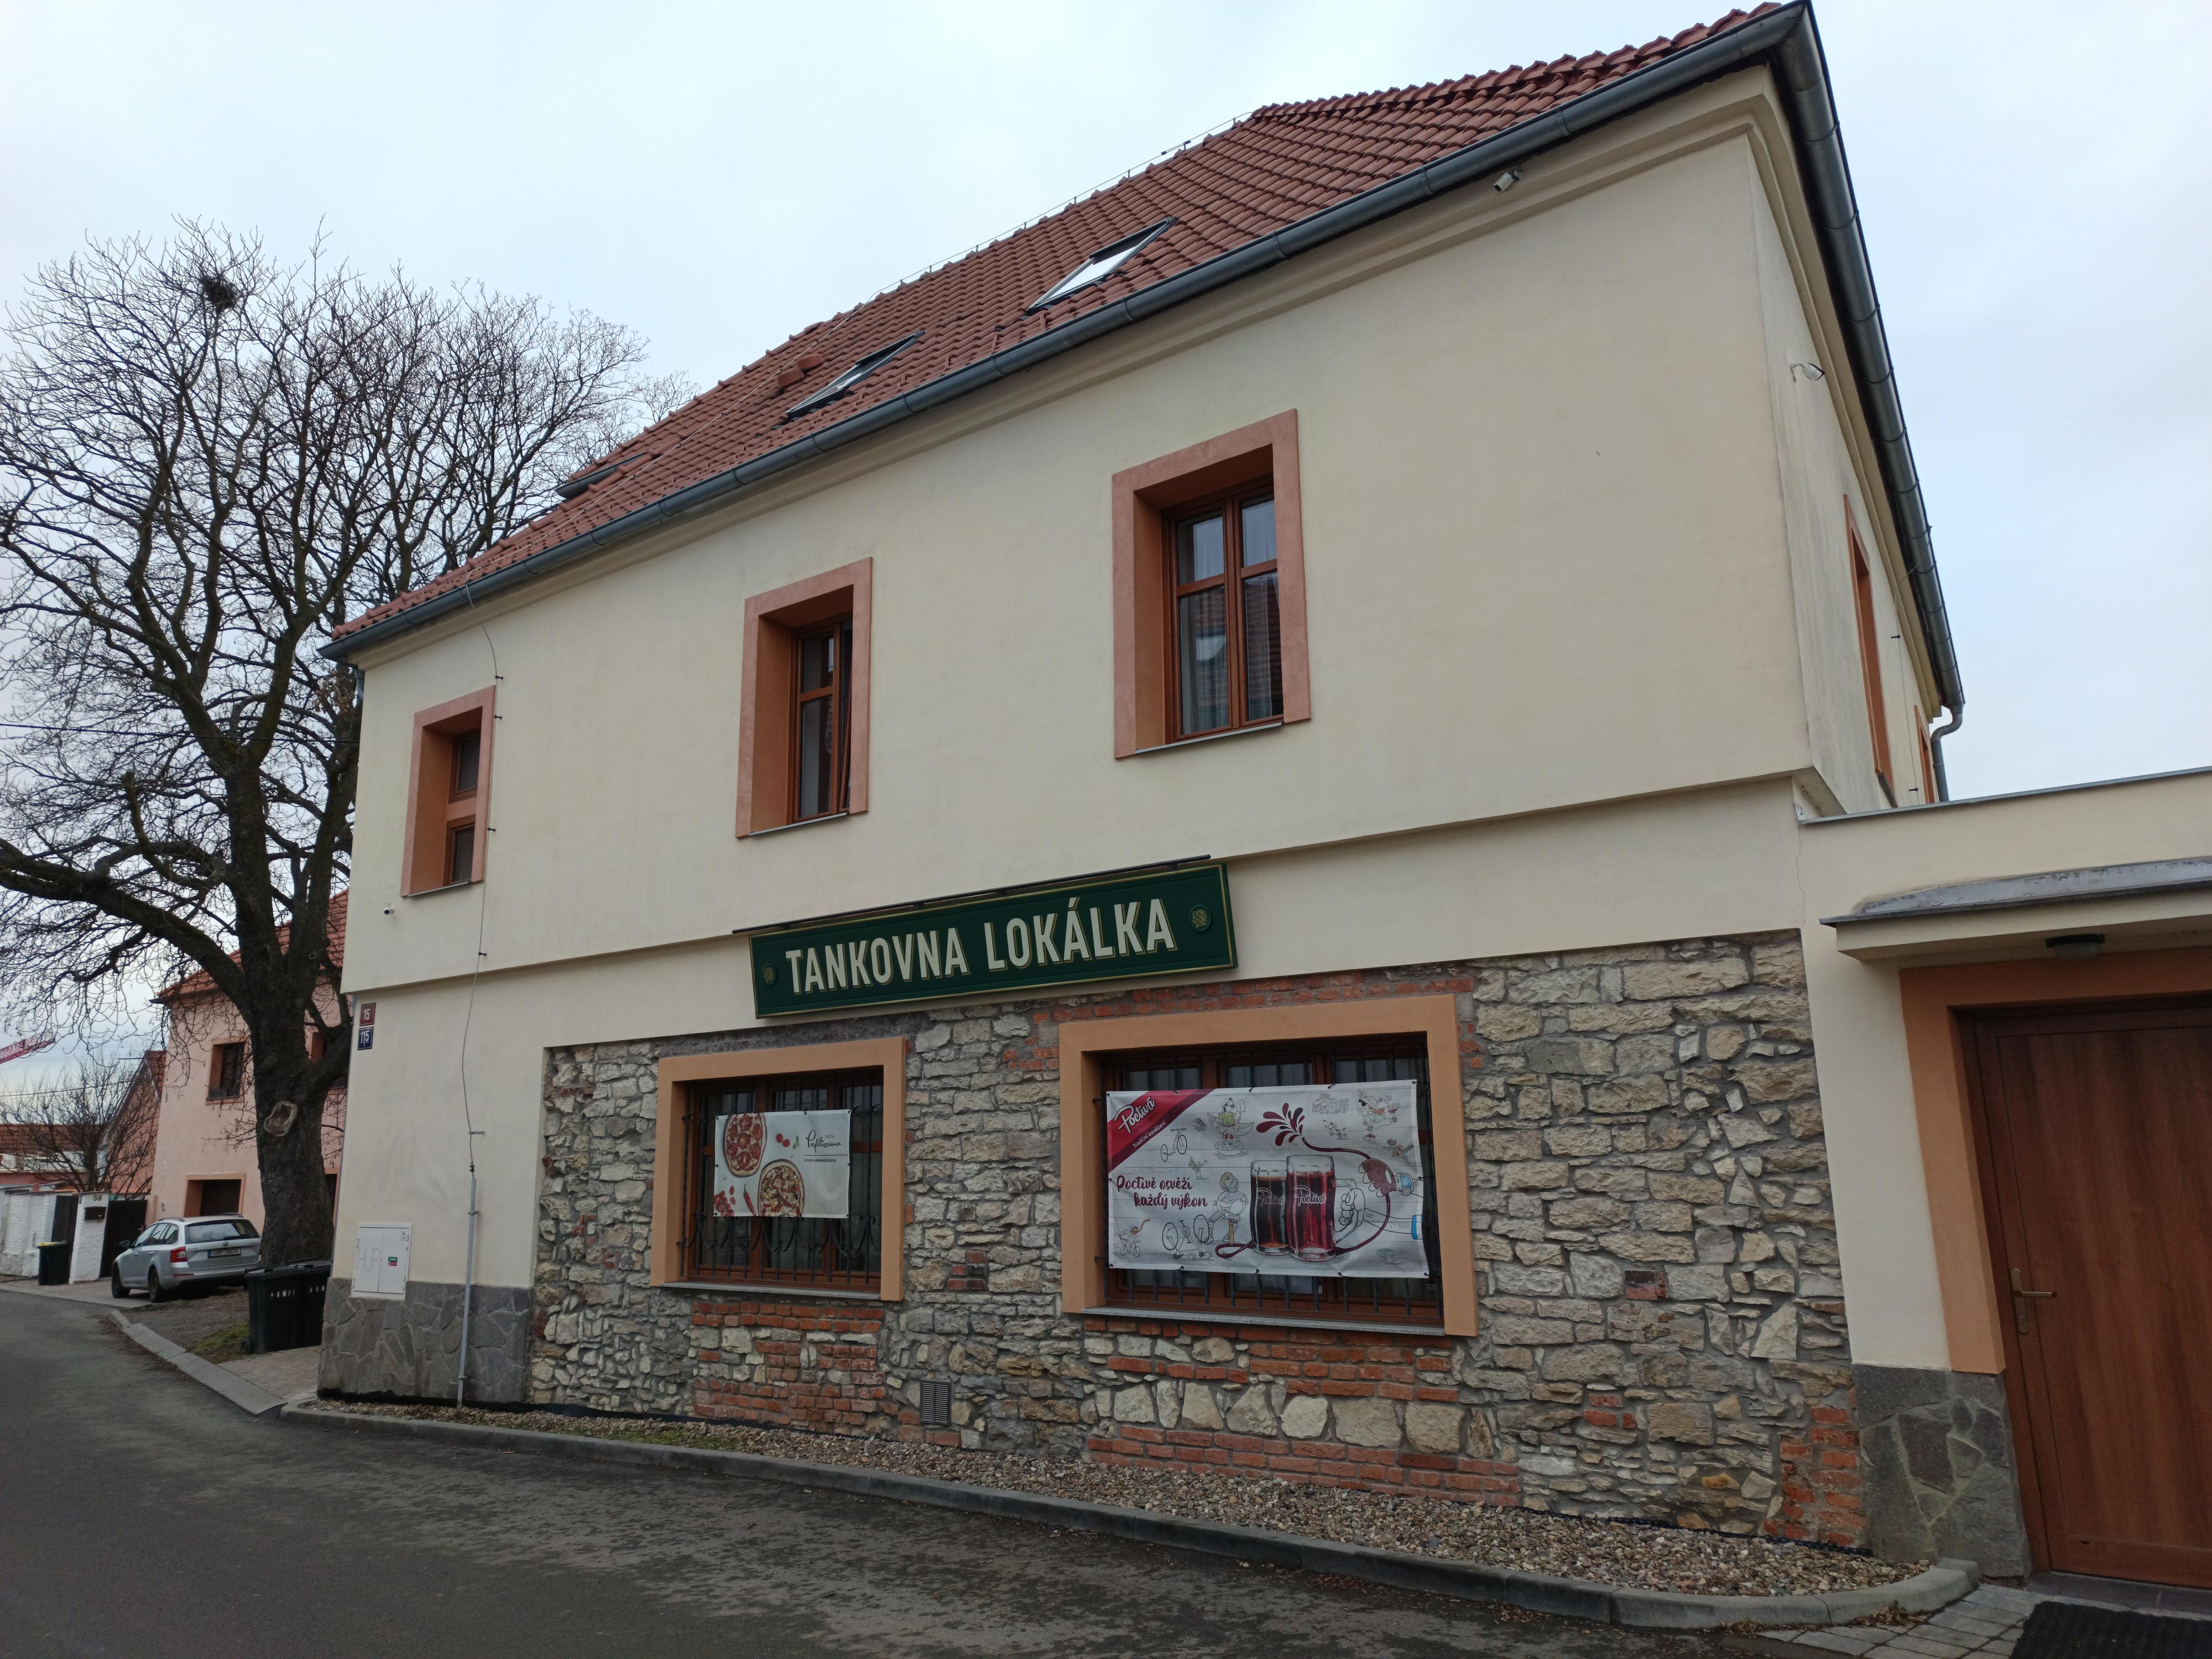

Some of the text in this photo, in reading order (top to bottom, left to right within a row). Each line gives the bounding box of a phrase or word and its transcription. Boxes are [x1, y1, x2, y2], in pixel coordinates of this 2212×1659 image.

[785, 896, 1178, 995] TANKOVNA LOKÁLKA
[363, 1008, 371, 1020] 15
[360, 1030, 370, 1042] 115
[1114, 1095, 1155, 1134] Poctivá
[806, 1130, 841, 1153] Perfettissima
[1133, 1120, 1166, 1149] Tradiční osvěžení
[1117, 1175, 1193, 1192] Poctivě osvěží
[1134, 1192, 1208, 1210] každý výkon
[1256, 1187, 1286, 1207] Poctivá
[1293, 1185, 1327, 1207] Poctivá
